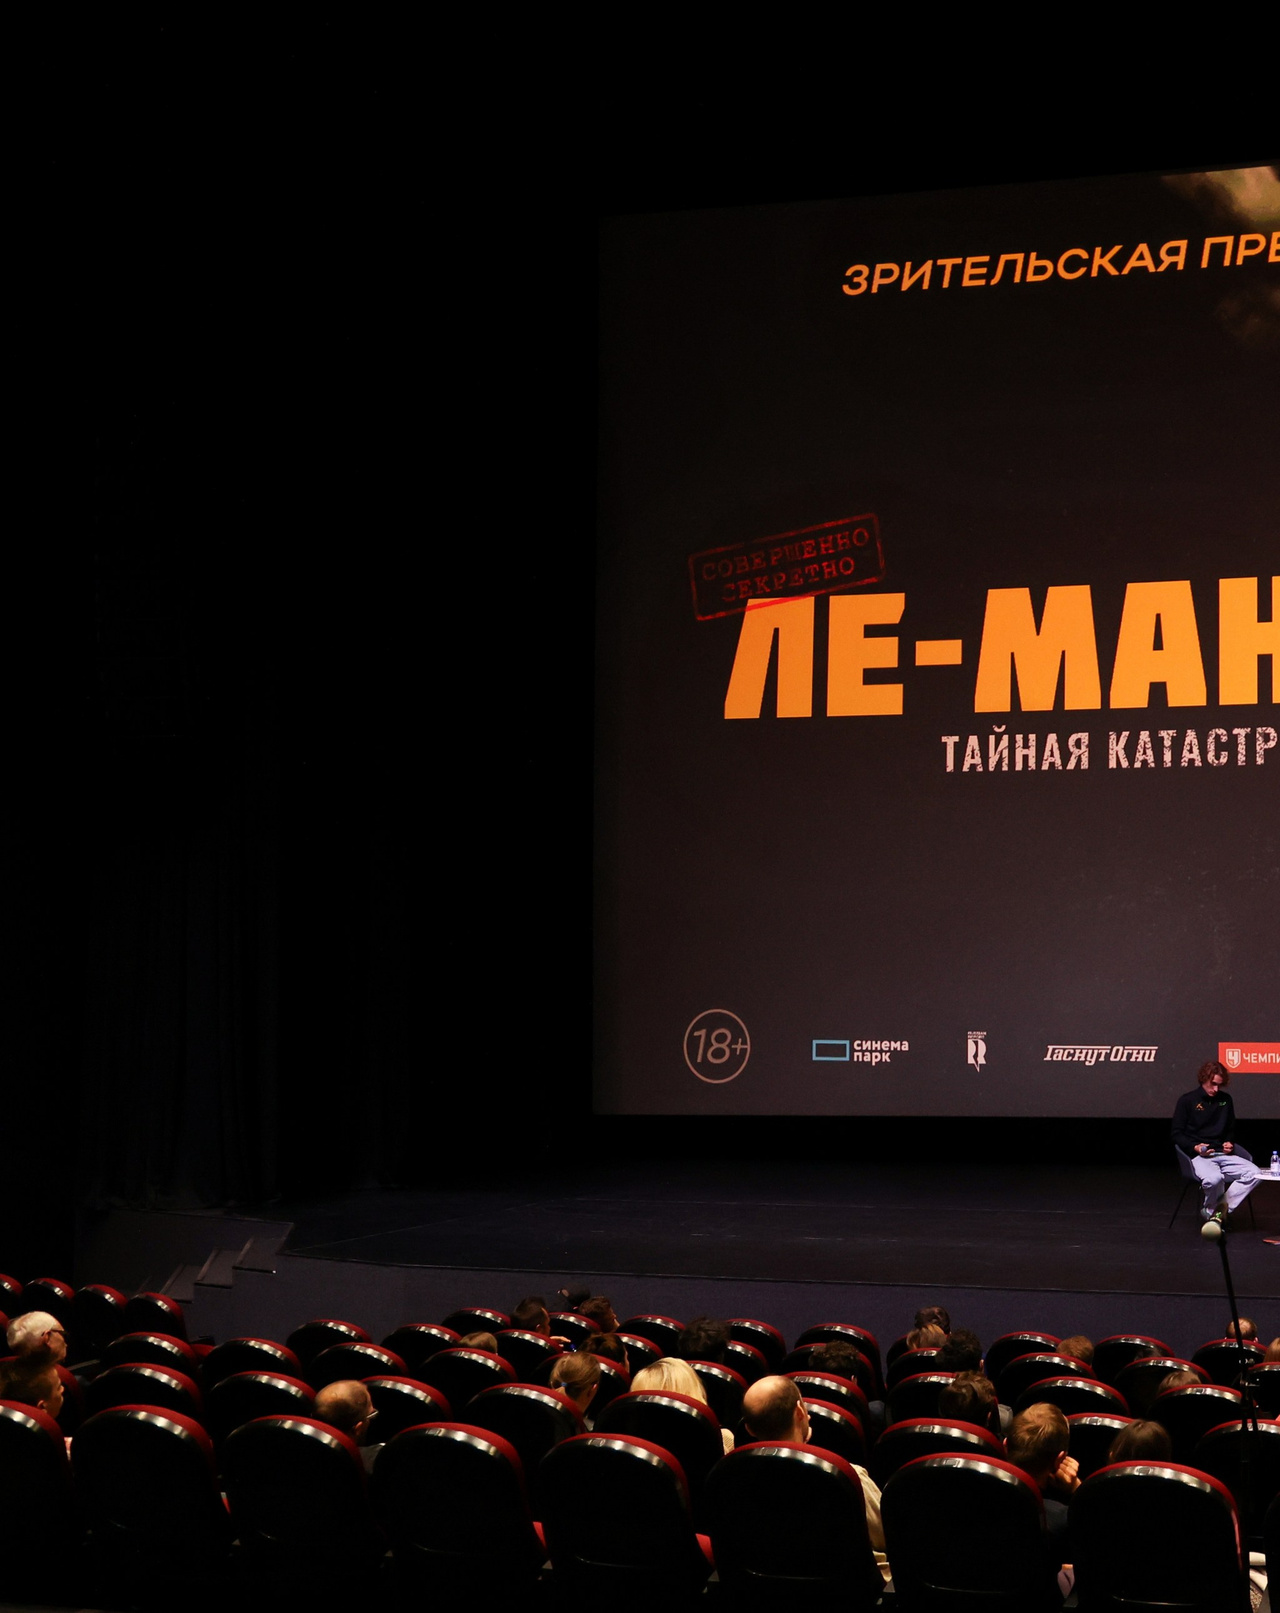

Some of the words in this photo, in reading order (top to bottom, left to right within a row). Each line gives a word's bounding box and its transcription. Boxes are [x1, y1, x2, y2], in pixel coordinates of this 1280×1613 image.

[843, 239, 1188, 297] ЗРИТЕЛЬСКАЯ
[702, 528, 869, 581] СОВЕРШЕННО
[721, 556, 855, 602] СЕКРЕТНО
[941, 725, 1090, 773] ТАЙНАЯ
[692, 1027, 749, 1065] 18+
[853, 1039, 910, 1052] синема
[853, 1051, 891, 1067] парк
